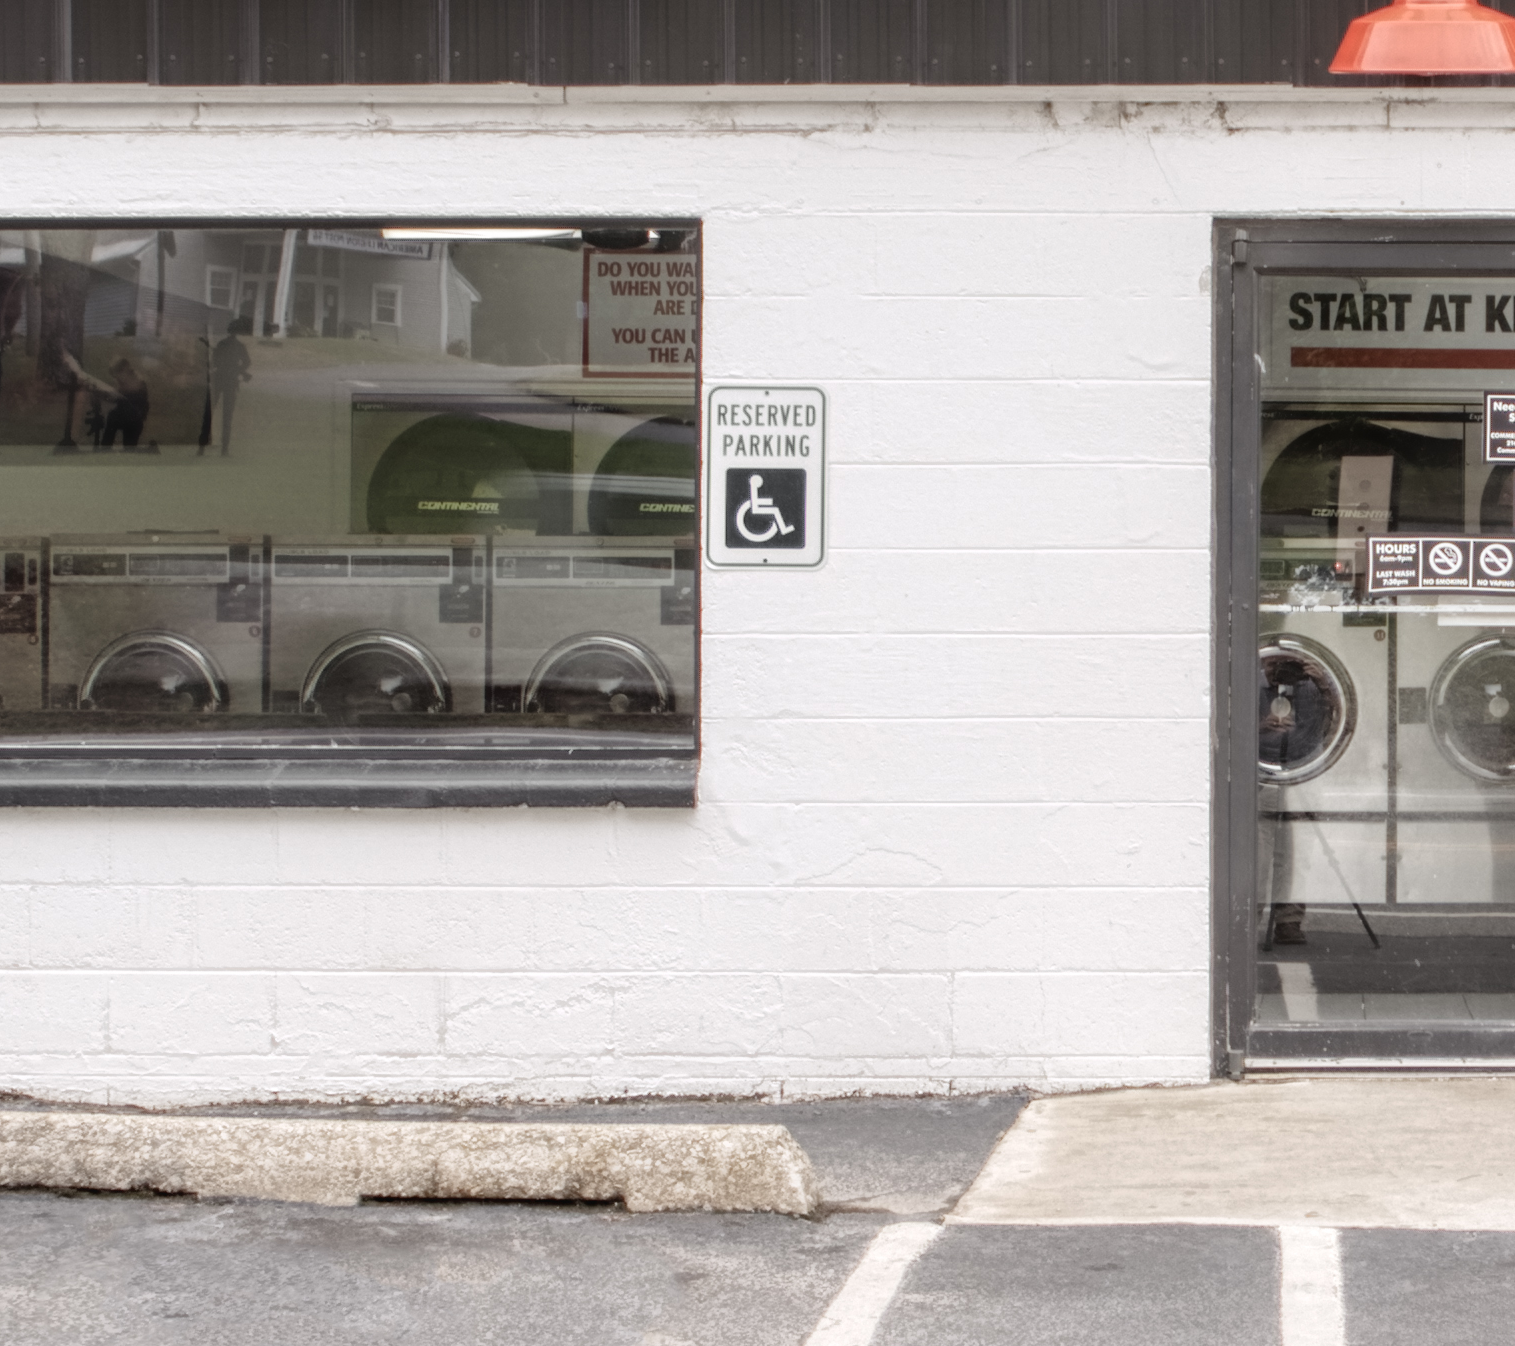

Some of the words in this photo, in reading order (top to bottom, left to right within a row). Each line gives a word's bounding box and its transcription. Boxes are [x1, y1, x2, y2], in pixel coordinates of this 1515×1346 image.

[597, 262, 622, 277] DO
[626, 262, 661, 277] YOU
[665, 262, 696, 277] WA
[610, 281, 661, 296] WHEN
[653, 300, 685, 315] ARE
[1288, 292, 1412, 332] START
[1423, 293, 1472, 332] AT
[612, 328, 646, 344] YOU
[650, 328, 686, 344] CAN
[648, 347, 679, 363] THE
[716, 404, 817, 427] RESERVED
[722, 434, 811, 458] PARKING
[418, 500, 500, 511] CONTINENTAL
[639, 503, 695, 513] CONTINE
[1311, 508, 1393, 519] CONTINENTAL
[1376, 543, 1417, 555] HOURS
[1376, 571, 1393, 579] LAST
[1394, 570, 1416, 578] WASH
[1423, 578, 1434, 586] NO
[1435, 578, 1469, 587] SMOKING
[1477, 579, 1488, 587] NO
[1489, 579, 1515, 588] VAPING
